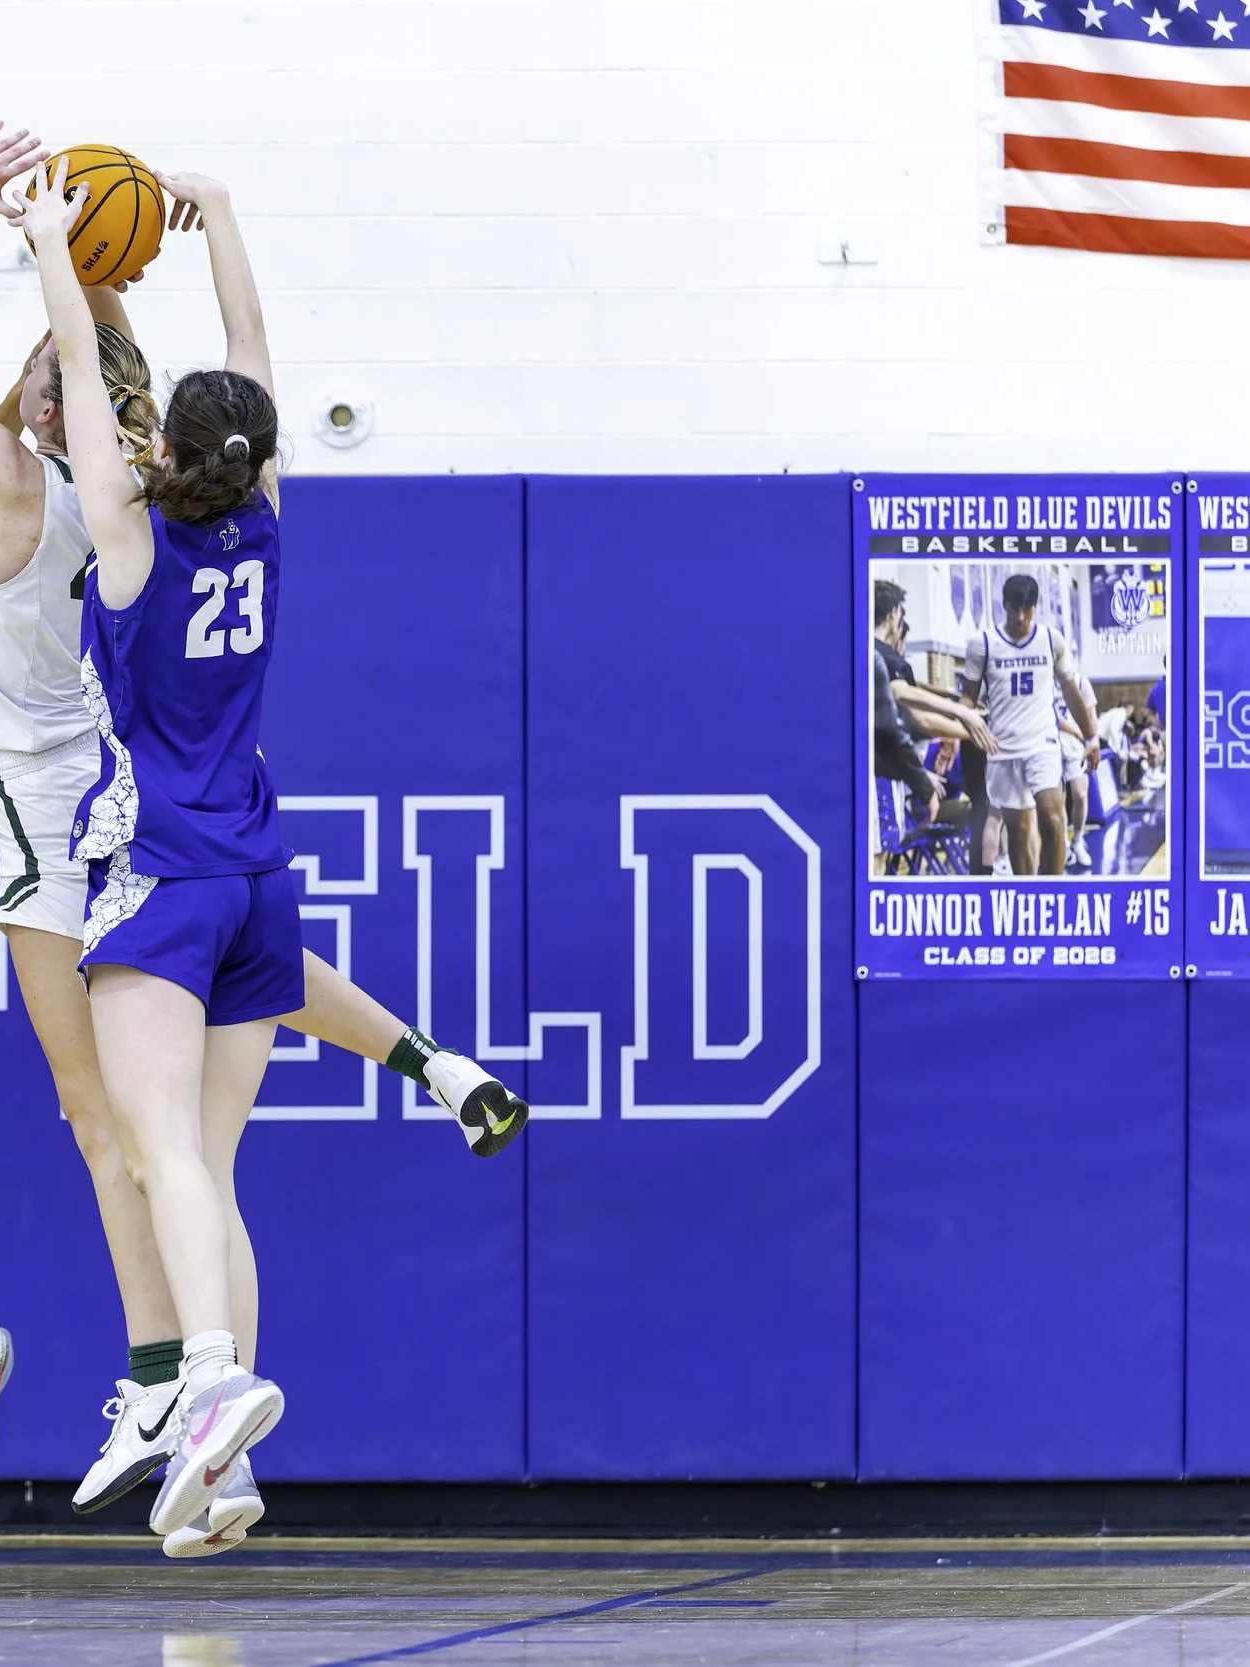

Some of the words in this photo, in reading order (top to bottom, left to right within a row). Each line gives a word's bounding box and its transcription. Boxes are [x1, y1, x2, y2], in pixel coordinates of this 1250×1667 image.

[868, 497, 1008, 529] WESTFIELD
[1017, 497, 1077, 529] BLUE
[1086, 496, 1170, 529] DEVILS
[902, 536, 1137, 552] BASKETBALL
[185, 560, 264, 658] 23
[1097, 632, 1161, 655] CAPTAIN
[1011, 671, 1033, 696] 15
[1126, 889, 1169, 935] #15
[924, 947, 1005, 964] CLASS
[1013, 947, 1045, 965] OF
[1053, 947, 1115, 964] 2026
